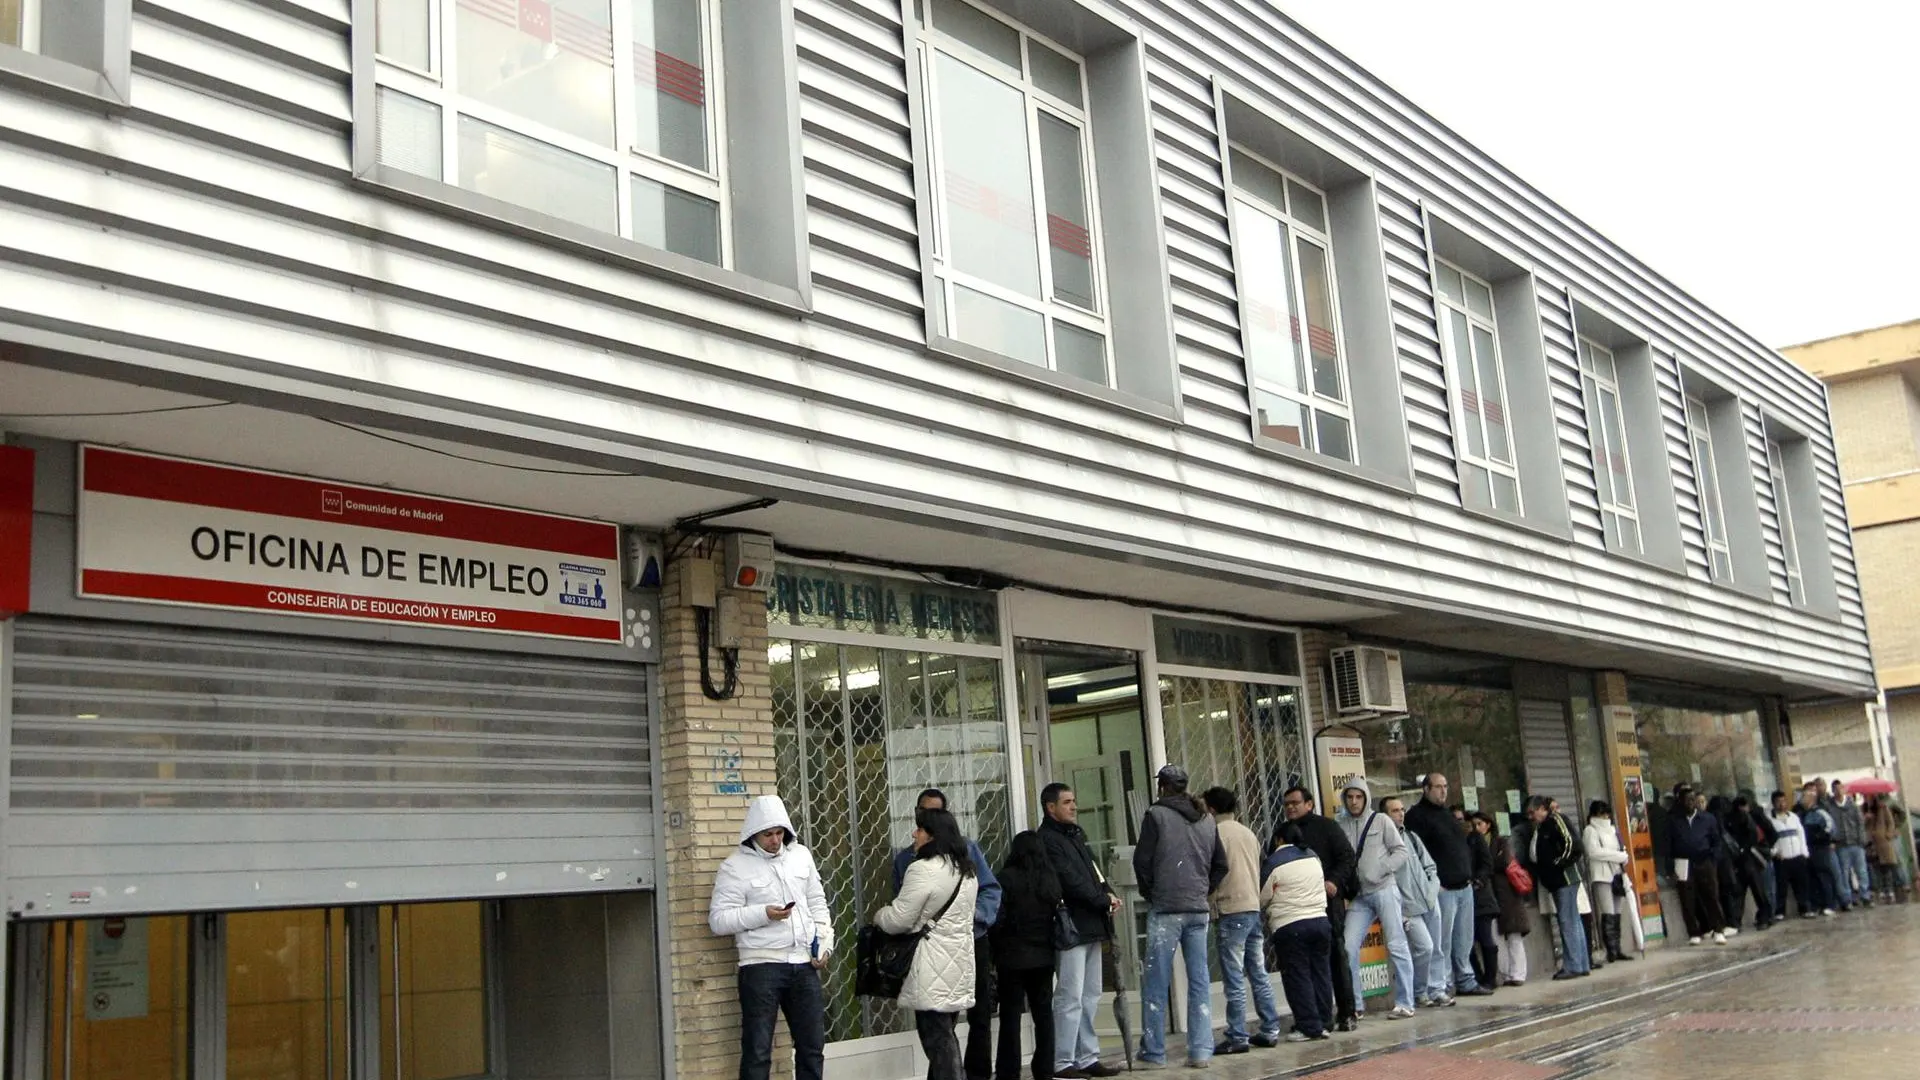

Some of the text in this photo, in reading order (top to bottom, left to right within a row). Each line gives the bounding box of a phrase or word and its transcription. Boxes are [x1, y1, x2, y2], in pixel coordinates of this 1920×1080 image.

[345, 500, 444, 521] Comunidad de Madrid
[191, 526, 549, 597] OFICINA DE EMPLEO
[267, 590, 497, 623] CONSEJERÍA DE EDUCACIÓN Y EMPLEO
[564, 595, 576, 604] 902
[577, 597, 589, 606] 365
